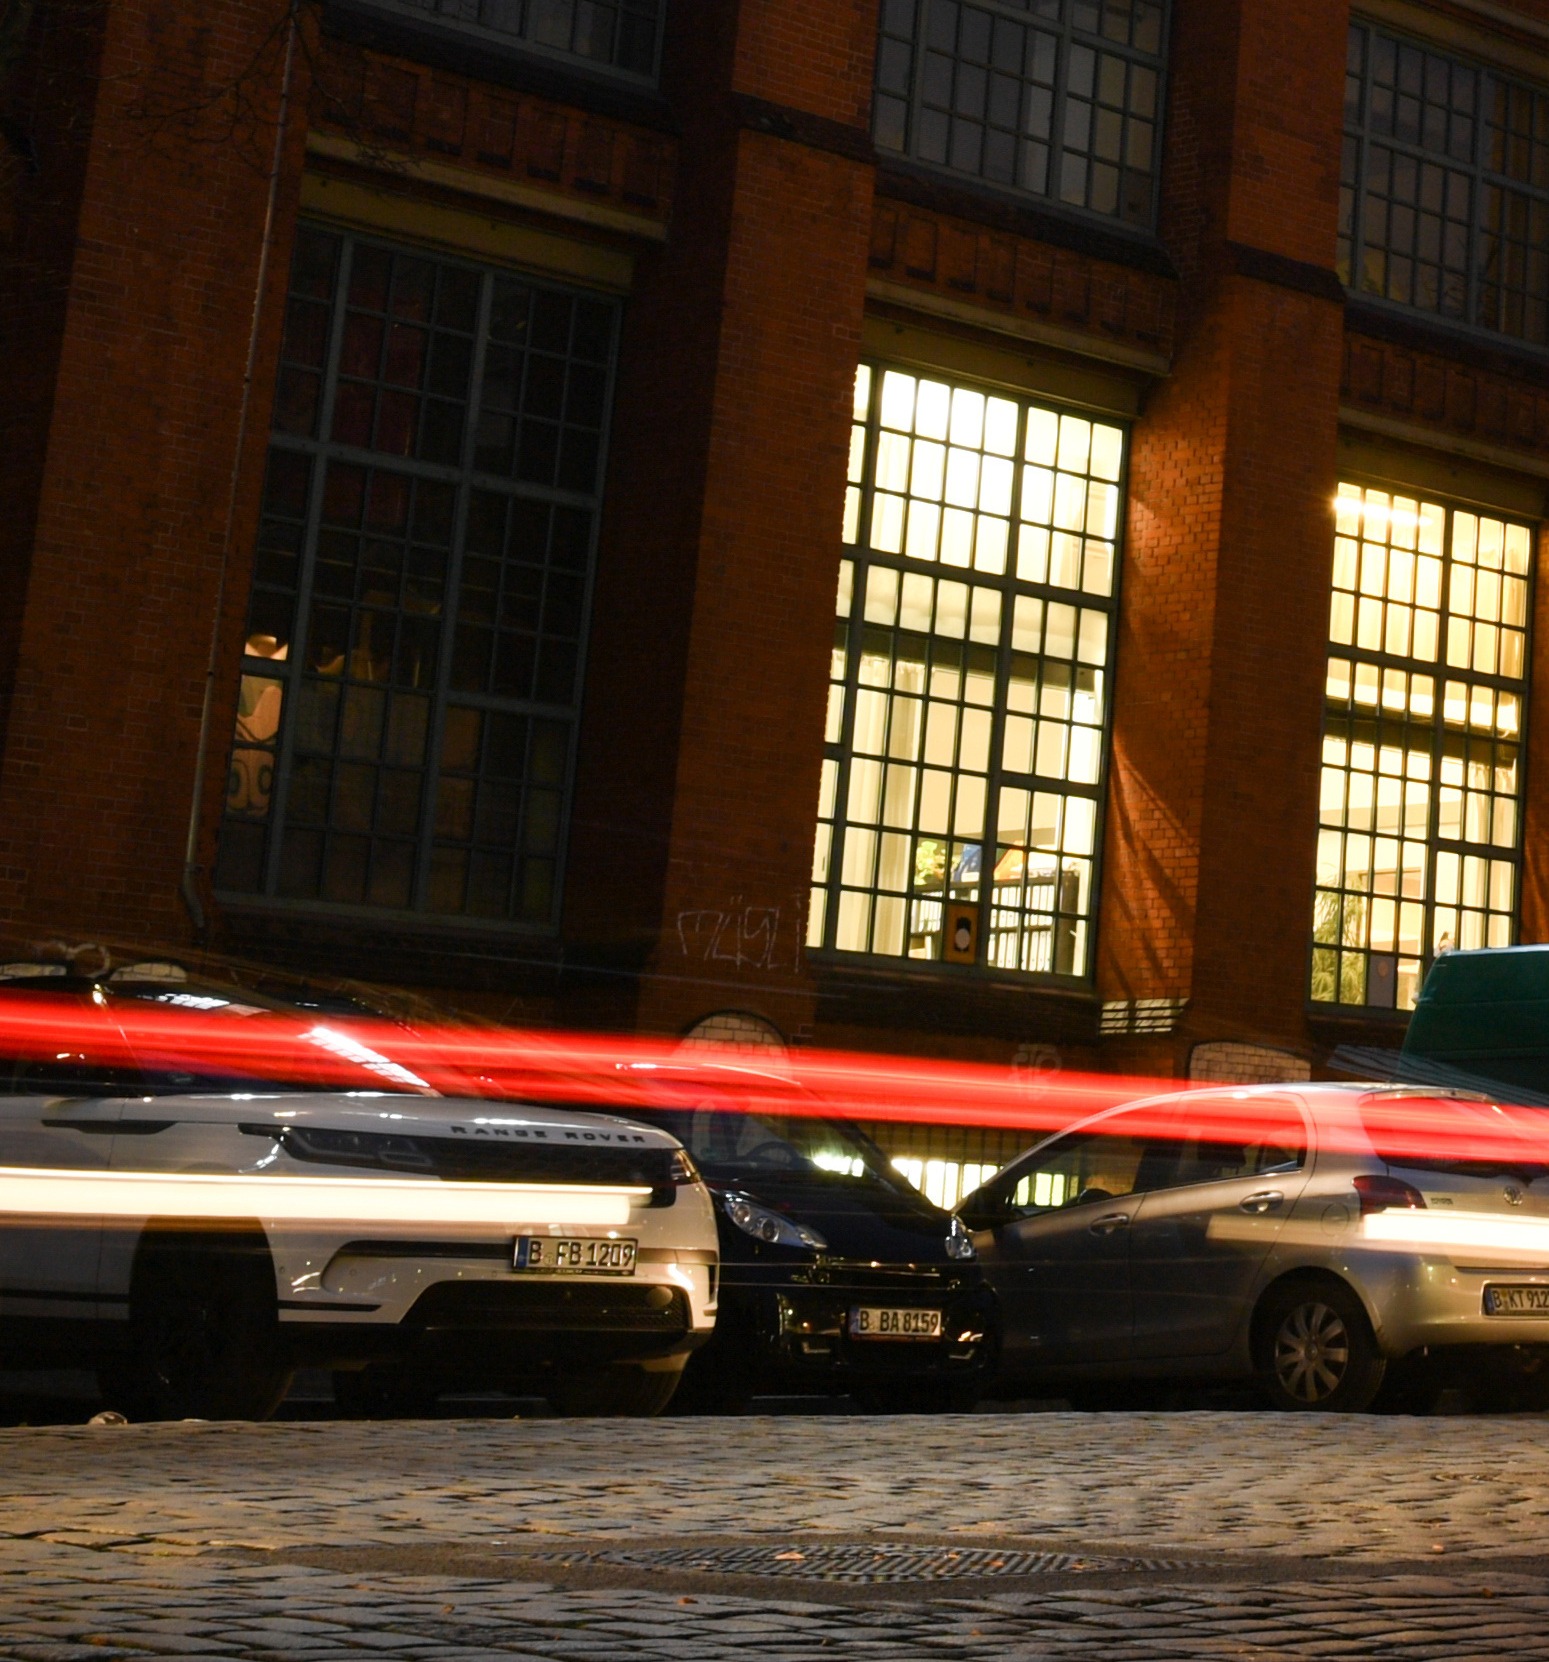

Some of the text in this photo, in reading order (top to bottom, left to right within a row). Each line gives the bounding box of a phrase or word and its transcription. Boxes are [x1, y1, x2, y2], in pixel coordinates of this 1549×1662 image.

[451, 1125, 646, 1143] RANGE ROVER
[528, 1240, 542, 1264] B
[1492, 1290, 1502, 1308] B
[1508, 1290, 1524, 1309] KT
[860, 1310, 940, 1333] B BA 8159
